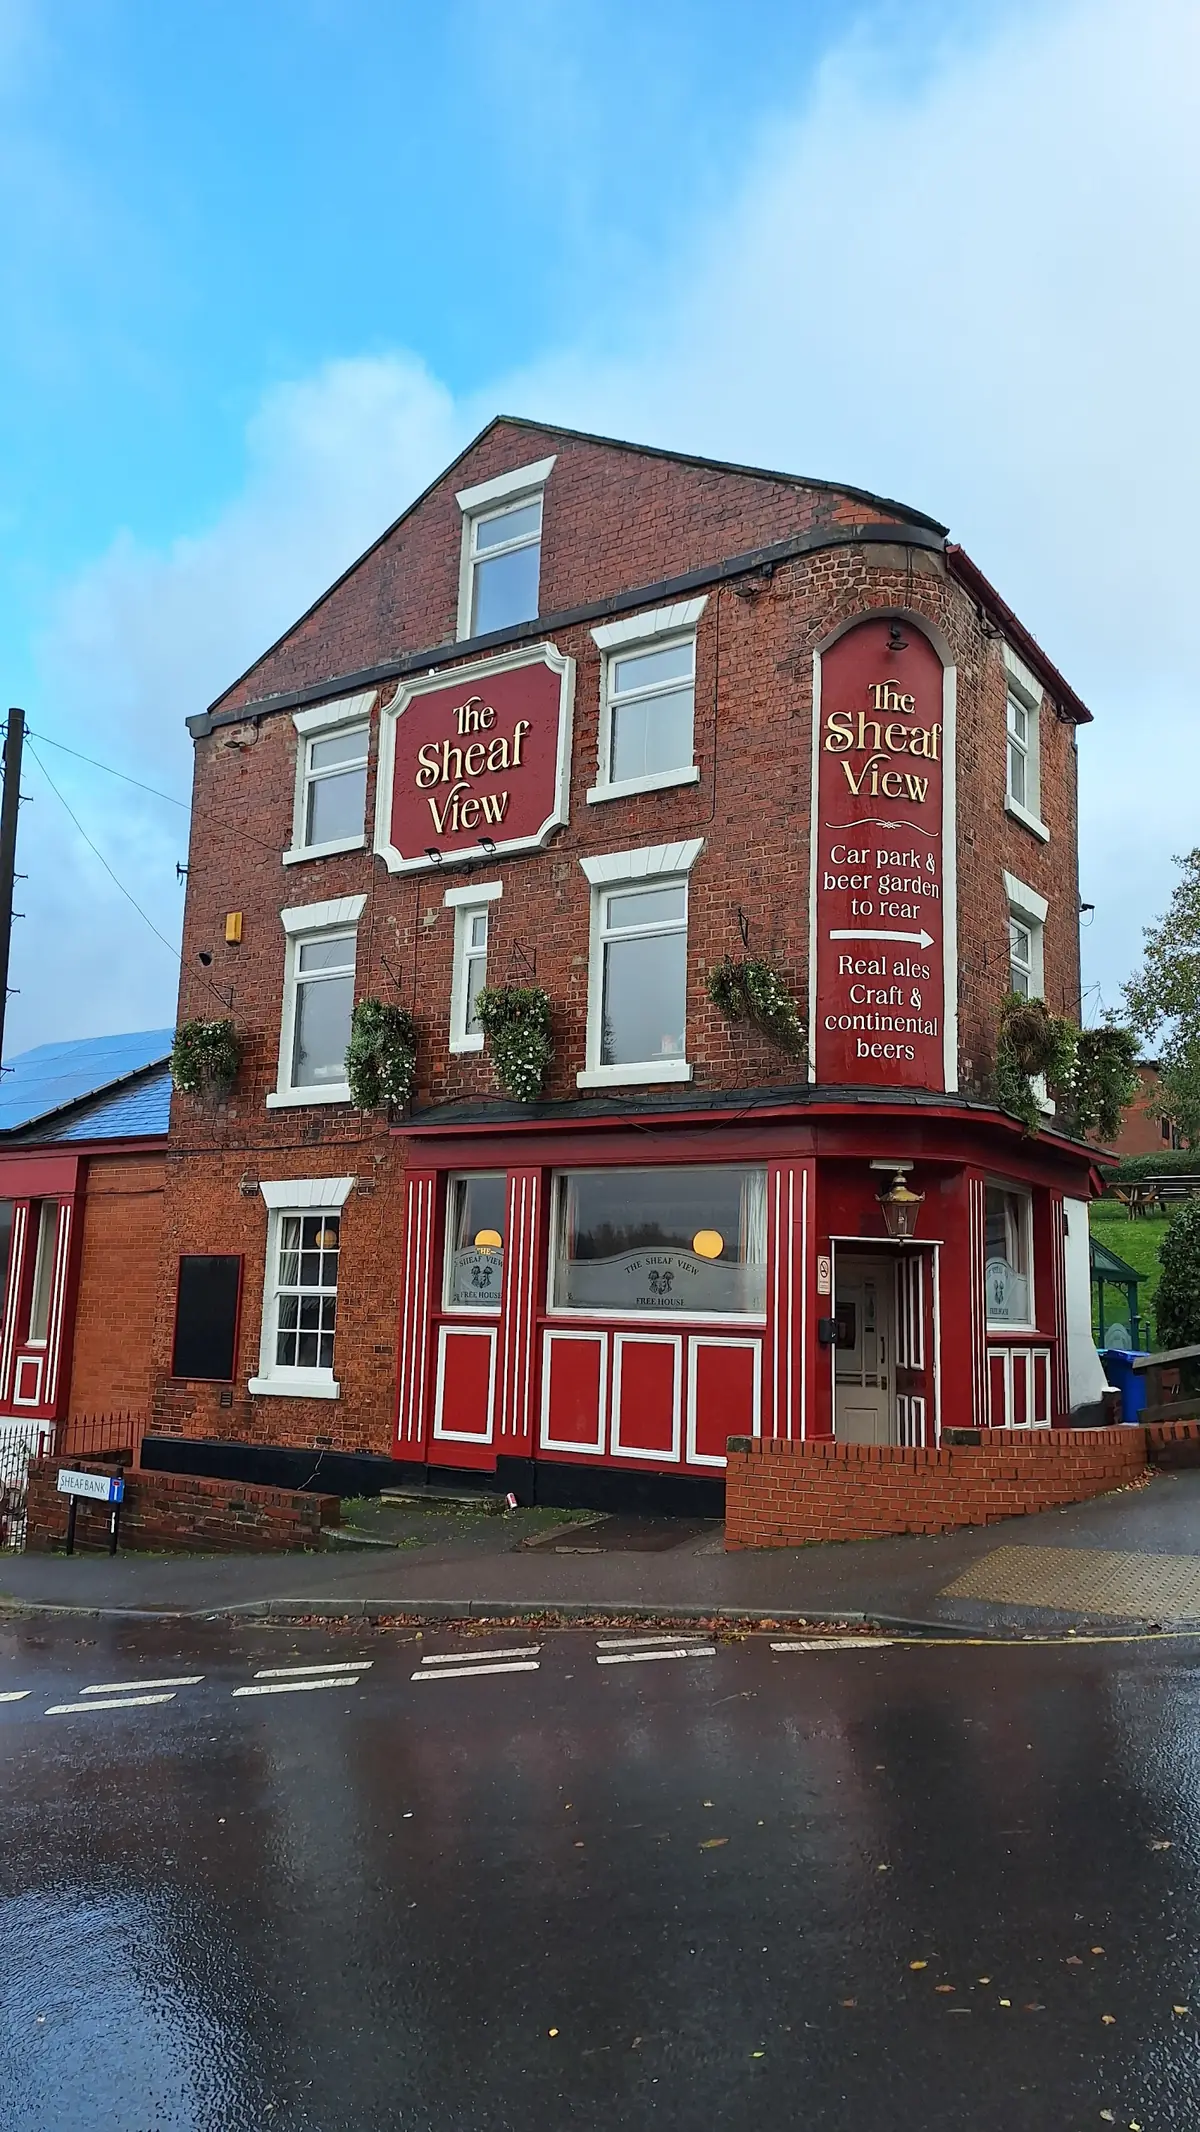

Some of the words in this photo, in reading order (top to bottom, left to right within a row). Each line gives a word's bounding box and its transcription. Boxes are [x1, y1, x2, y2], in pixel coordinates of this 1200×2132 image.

[868, 679, 916, 713] The
[453, 695, 495, 735] The
[824, 711, 942, 761] Sheaf
[415, 720, 530, 788] Sheaf
[840, 753, 929, 803] View
[428, 782, 508, 834] View
[830, 844, 870, 864] Car
[876, 848, 921, 869] park
[925, 852, 935, 875] &
[823, 872, 873, 890] beer
[878, 874, 939, 899] garden
[851, 898, 873, 916] to
[879, 901, 920, 919] rear
[838, 955, 886, 976] Real
[892, 958, 930, 980] ales
[850, 984, 904, 1006] Craft
[910, 987, 922, 1010] &
[824, 1012, 937, 1036] continental
[856, 1038, 915, 1060] beers
[459, 1256, 483, 1267] SHEAF
[624, 1260, 643, 1274] THE
[645, 1257, 674, 1266] SHEAF
[677, 1260, 699, 1276] VIEW
[636, 1297, 657, 1305] FREE
[657, 1298, 685, 1306] HOUSE
